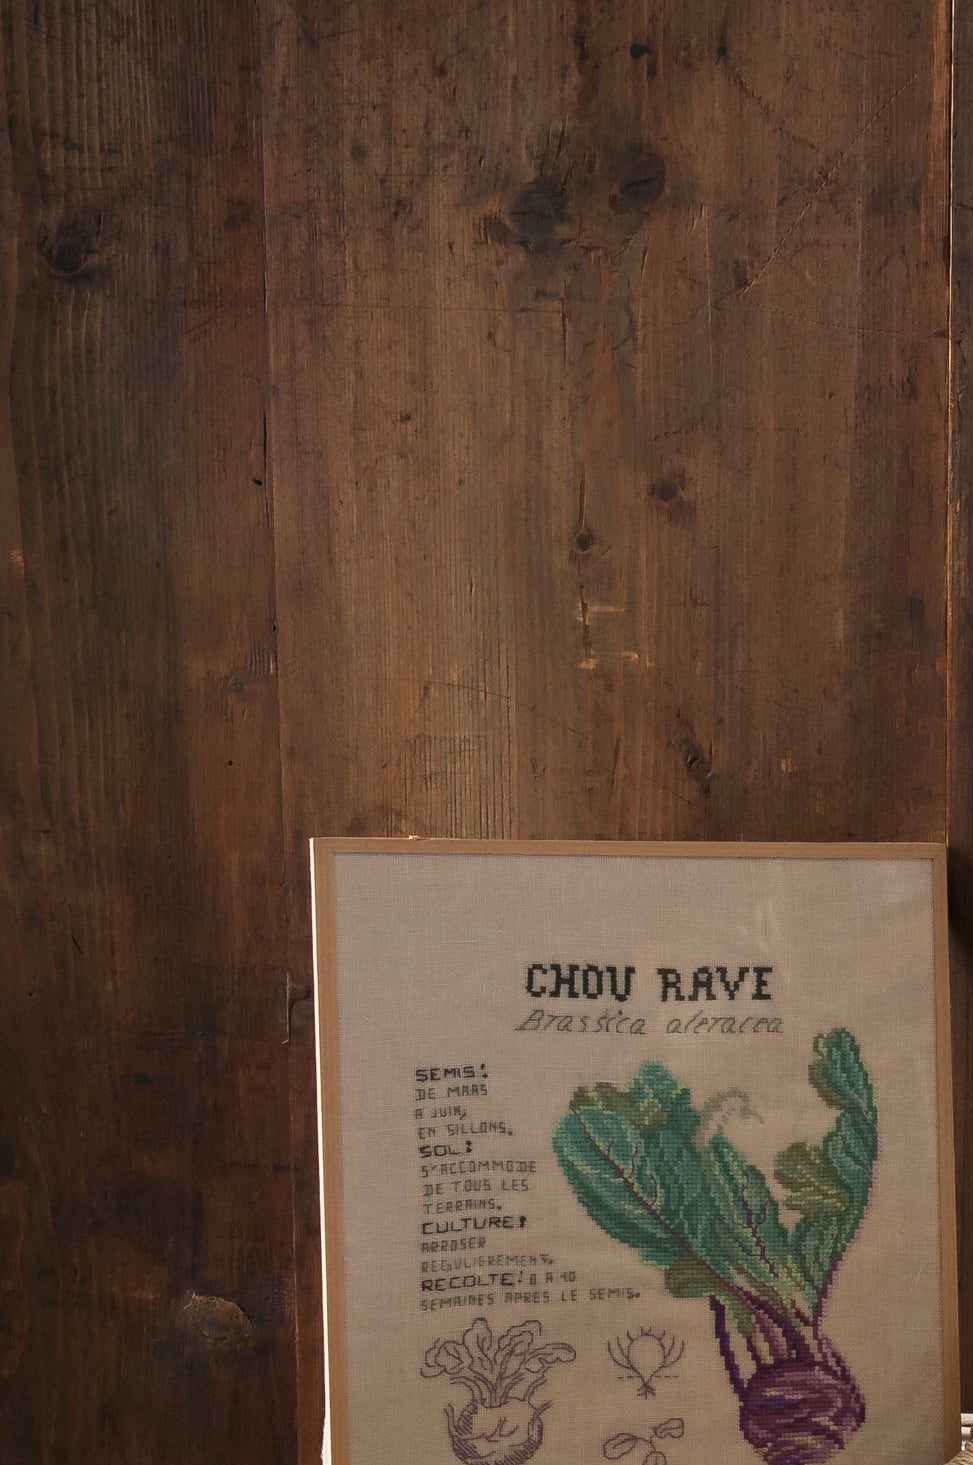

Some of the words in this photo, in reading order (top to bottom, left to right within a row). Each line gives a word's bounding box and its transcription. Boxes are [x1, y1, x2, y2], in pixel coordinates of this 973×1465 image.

[525, 963, 636, 1003] CHOU
[657, 965, 773, 1002] RAVE
[514, 1009, 646, 1035] Brassica
[415, 1088, 436, 1101] DE
[447, 1085, 488, 1098] MARS
[417, 1126, 436, 1139] EN
[422, 1183, 444, 1197] DE
[452, 1179, 491, 1194] TOUS
[501, 1177, 529, 1192] LES
[423, 1198, 502, 1215] TERRAINS.
[420, 1236, 486, 1253] ARROSER
[546, 1272, 554, 1284] A
[560, 1271, 576, 1283] 10
[419, 1293, 494, 1311] SEMAINES
[504, 1289, 550, 1304] APRES
[561, 1288, 578, 1302] LE
